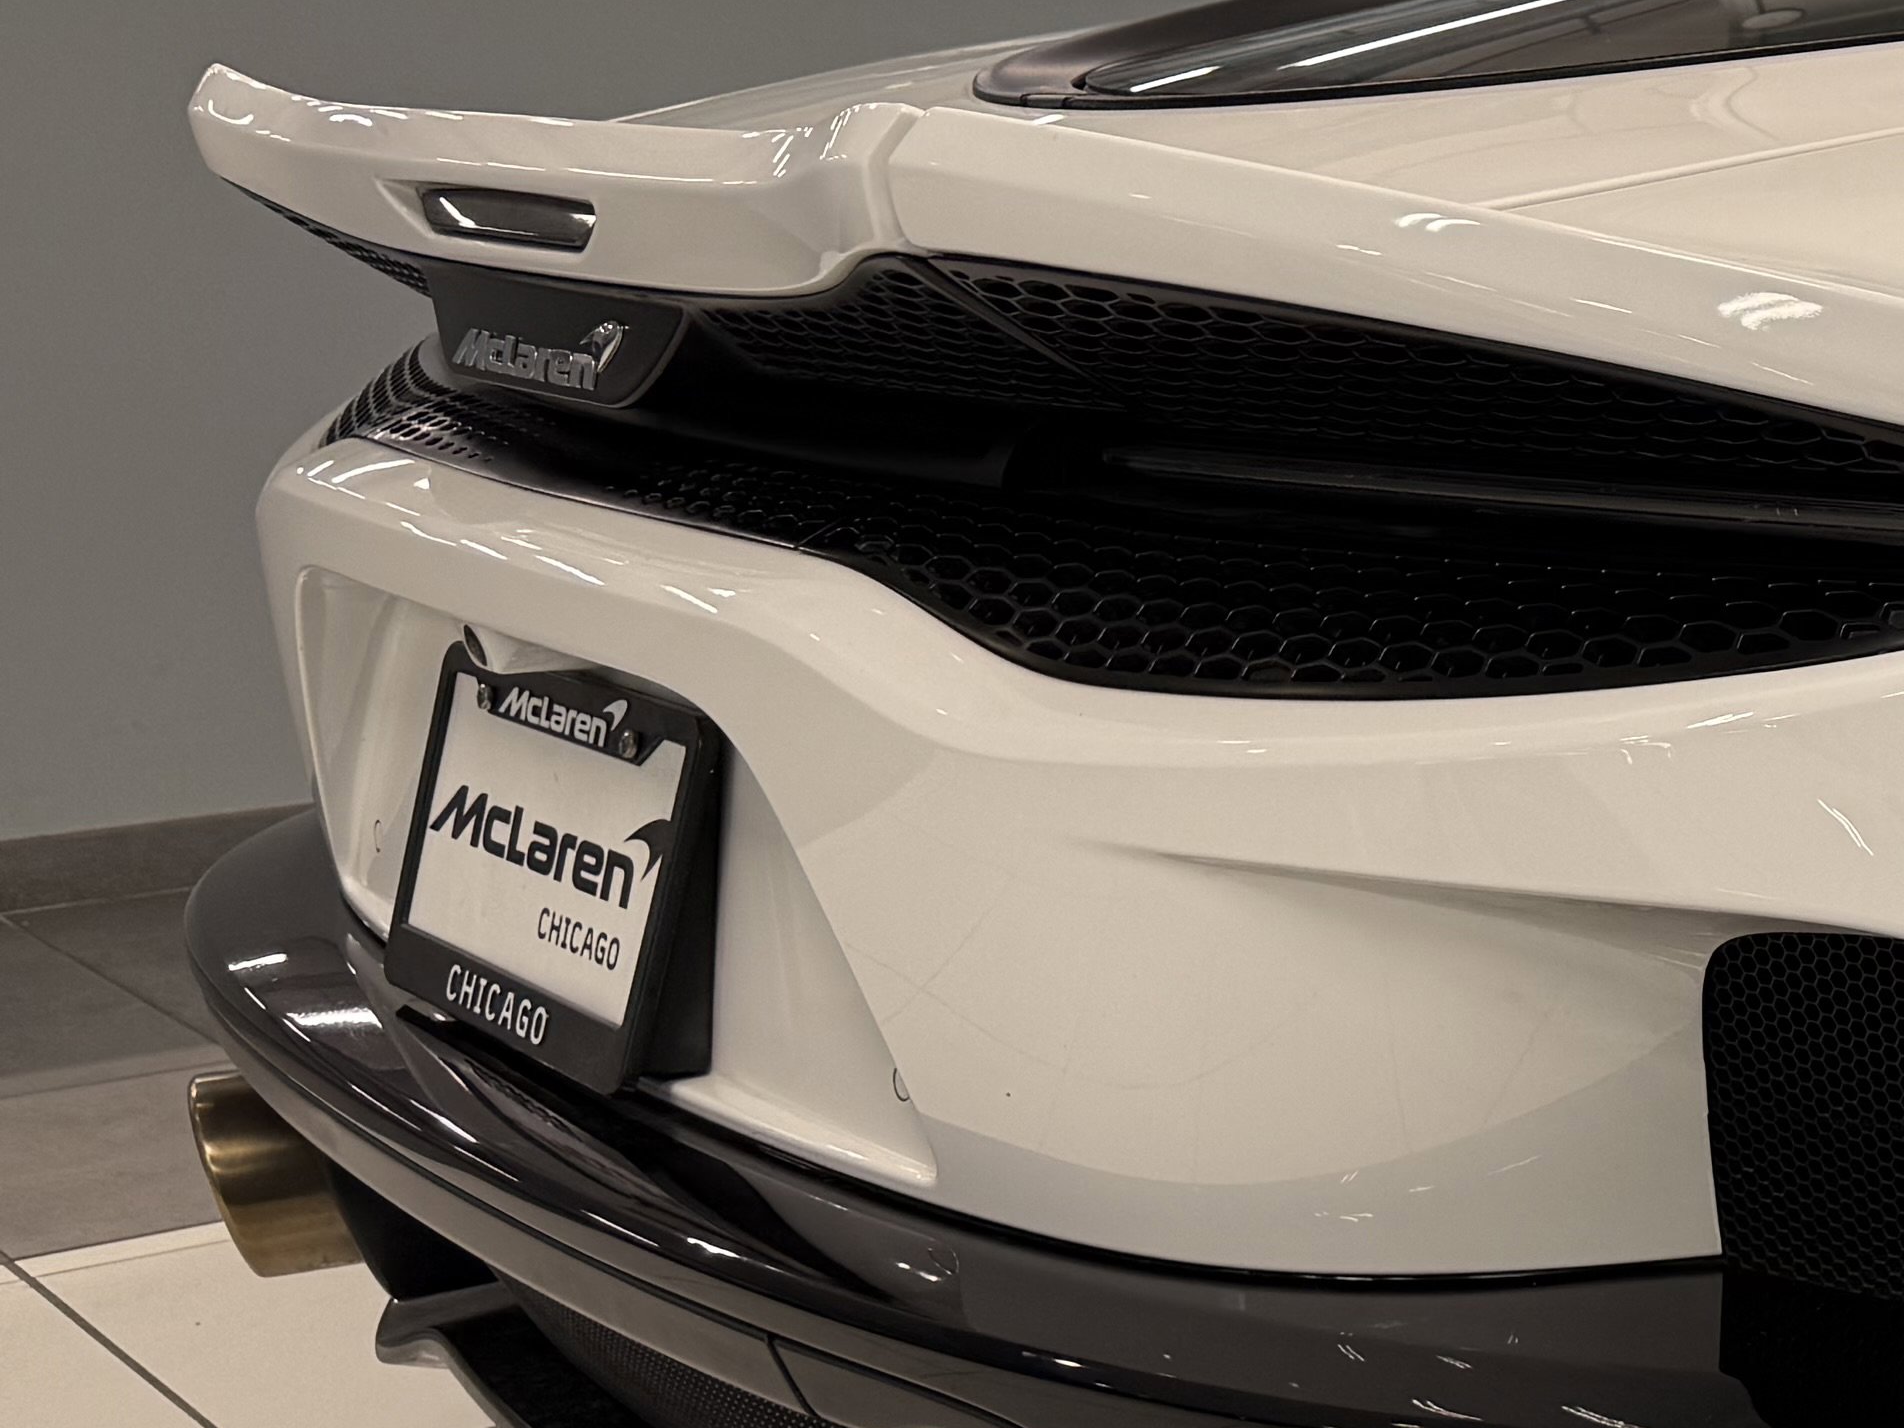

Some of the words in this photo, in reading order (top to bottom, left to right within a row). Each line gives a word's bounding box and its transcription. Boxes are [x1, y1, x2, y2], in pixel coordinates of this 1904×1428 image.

[452, 326, 600, 391] McLaren
[498, 686, 608, 748] McLaren
[429, 784, 635, 910] McLaren
[537, 907, 621, 971] CHICAGO
[446, 963, 549, 1045] CHICAGO
